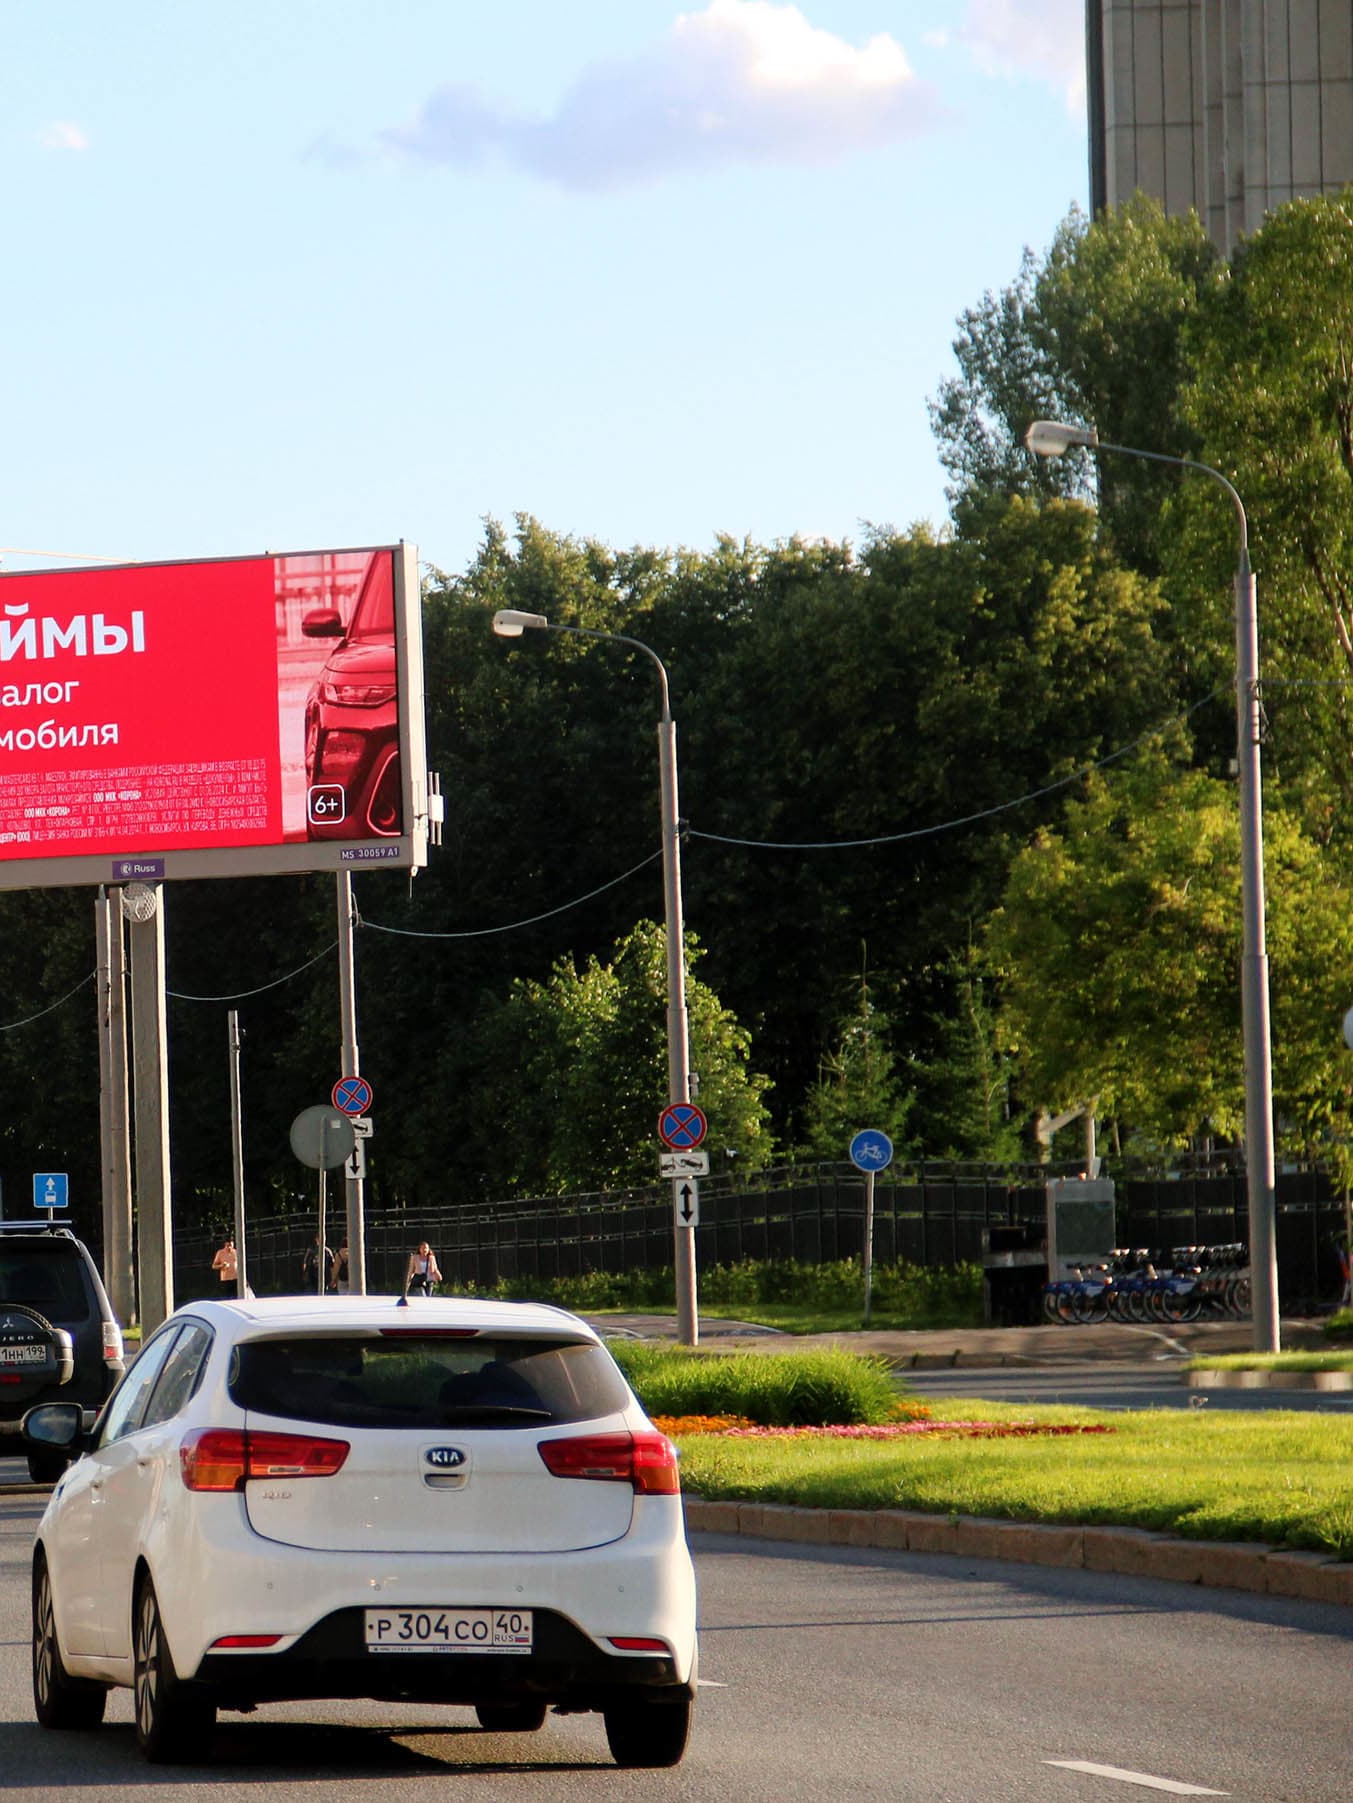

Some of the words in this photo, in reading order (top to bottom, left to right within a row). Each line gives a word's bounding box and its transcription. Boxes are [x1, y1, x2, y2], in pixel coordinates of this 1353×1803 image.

[315, 796, 338, 813] 6+
[342, 850, 354, 859] MS
[359, 848, 386, 857] 30059
[388, 847, 398, 856] A1
[134, 863, 156, 874] Russ
[26, 1346, 44, 1356] 199
[431, 1450, 460, 1463] KIA
[377, 1613, 489, 1641] Р304СО
[496, 1614, 523, 1634] 40
[494, 1634, 514, 1643] RUS
